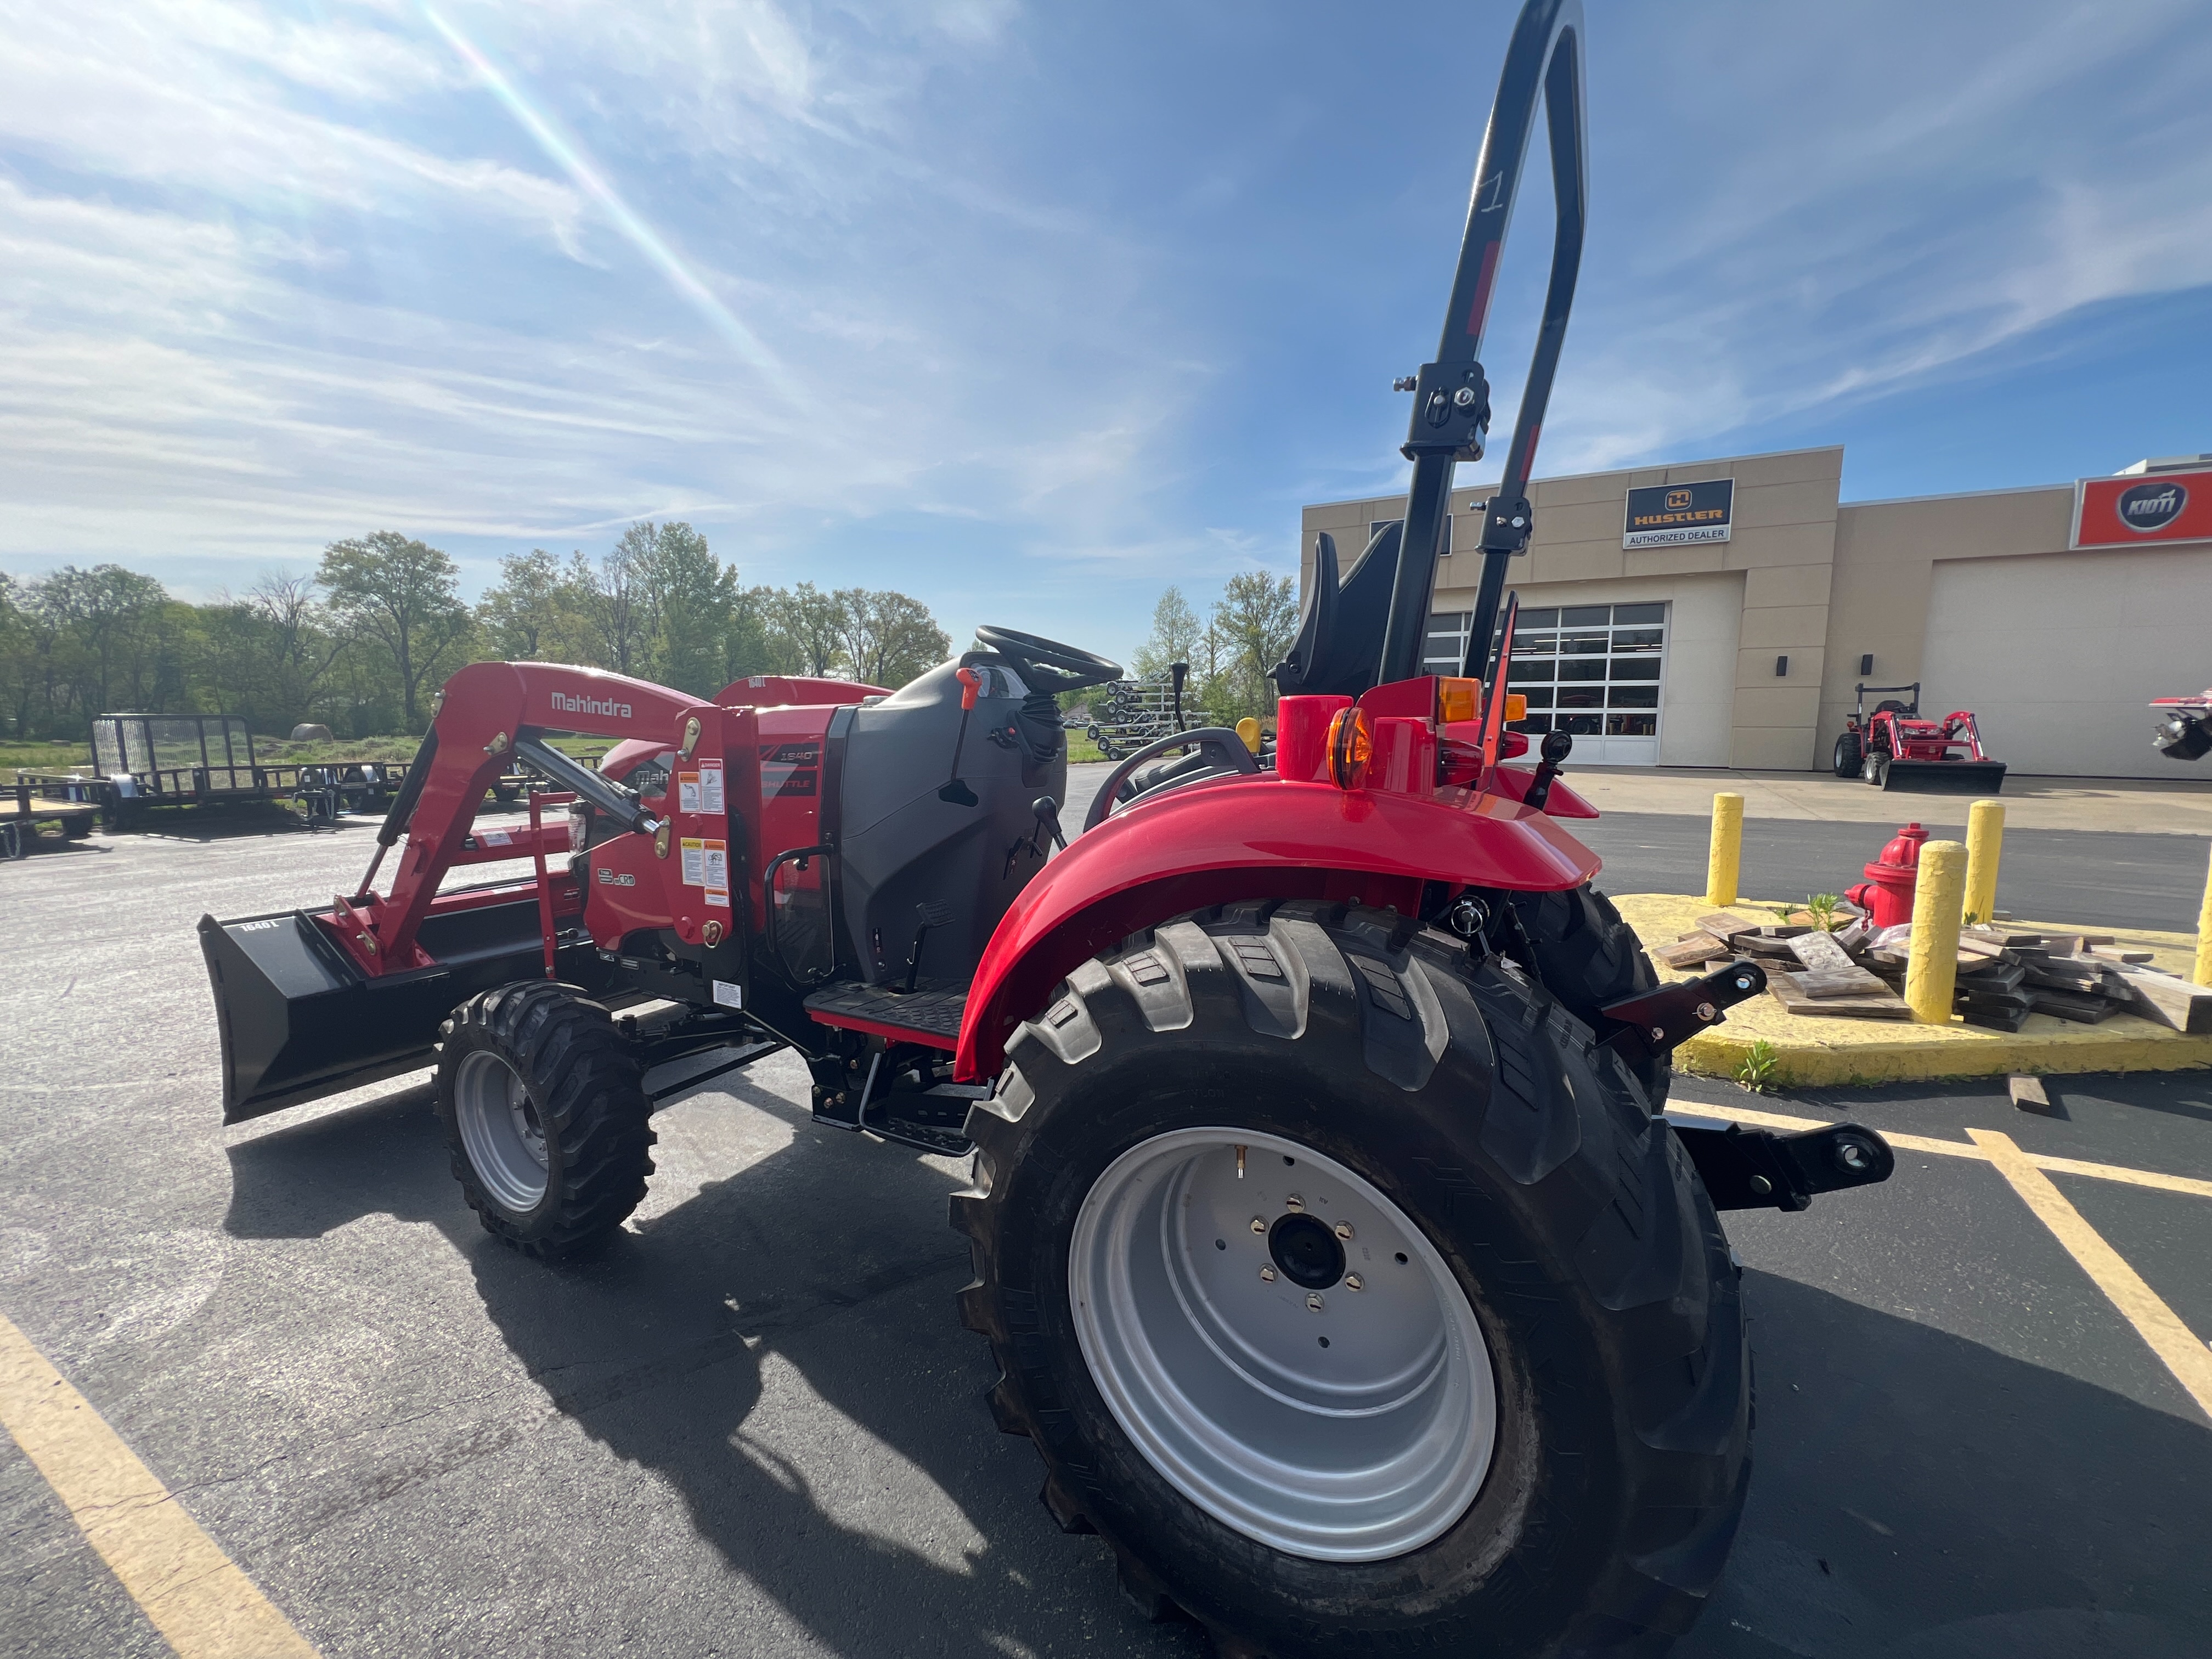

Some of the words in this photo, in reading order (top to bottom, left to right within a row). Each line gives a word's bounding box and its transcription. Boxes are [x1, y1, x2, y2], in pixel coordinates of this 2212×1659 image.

[2128, 498, 2176, 515] KIOTI
[1634, 510, 1723, 525] HUSTLER
[1629, 533, 1685, 545] AUTHORIZED
[1688, 529, 1724, 540] DEALER
[748, 678, 762, 689] 1640
[551, 691, 632, 718] Mahindra
[780, 752, 812, 761] 1640
[635, 769, 672, 785] Mah
[761, 780, 810, 788] SHUTTLE
[240, 922, 270, 932] 1640
